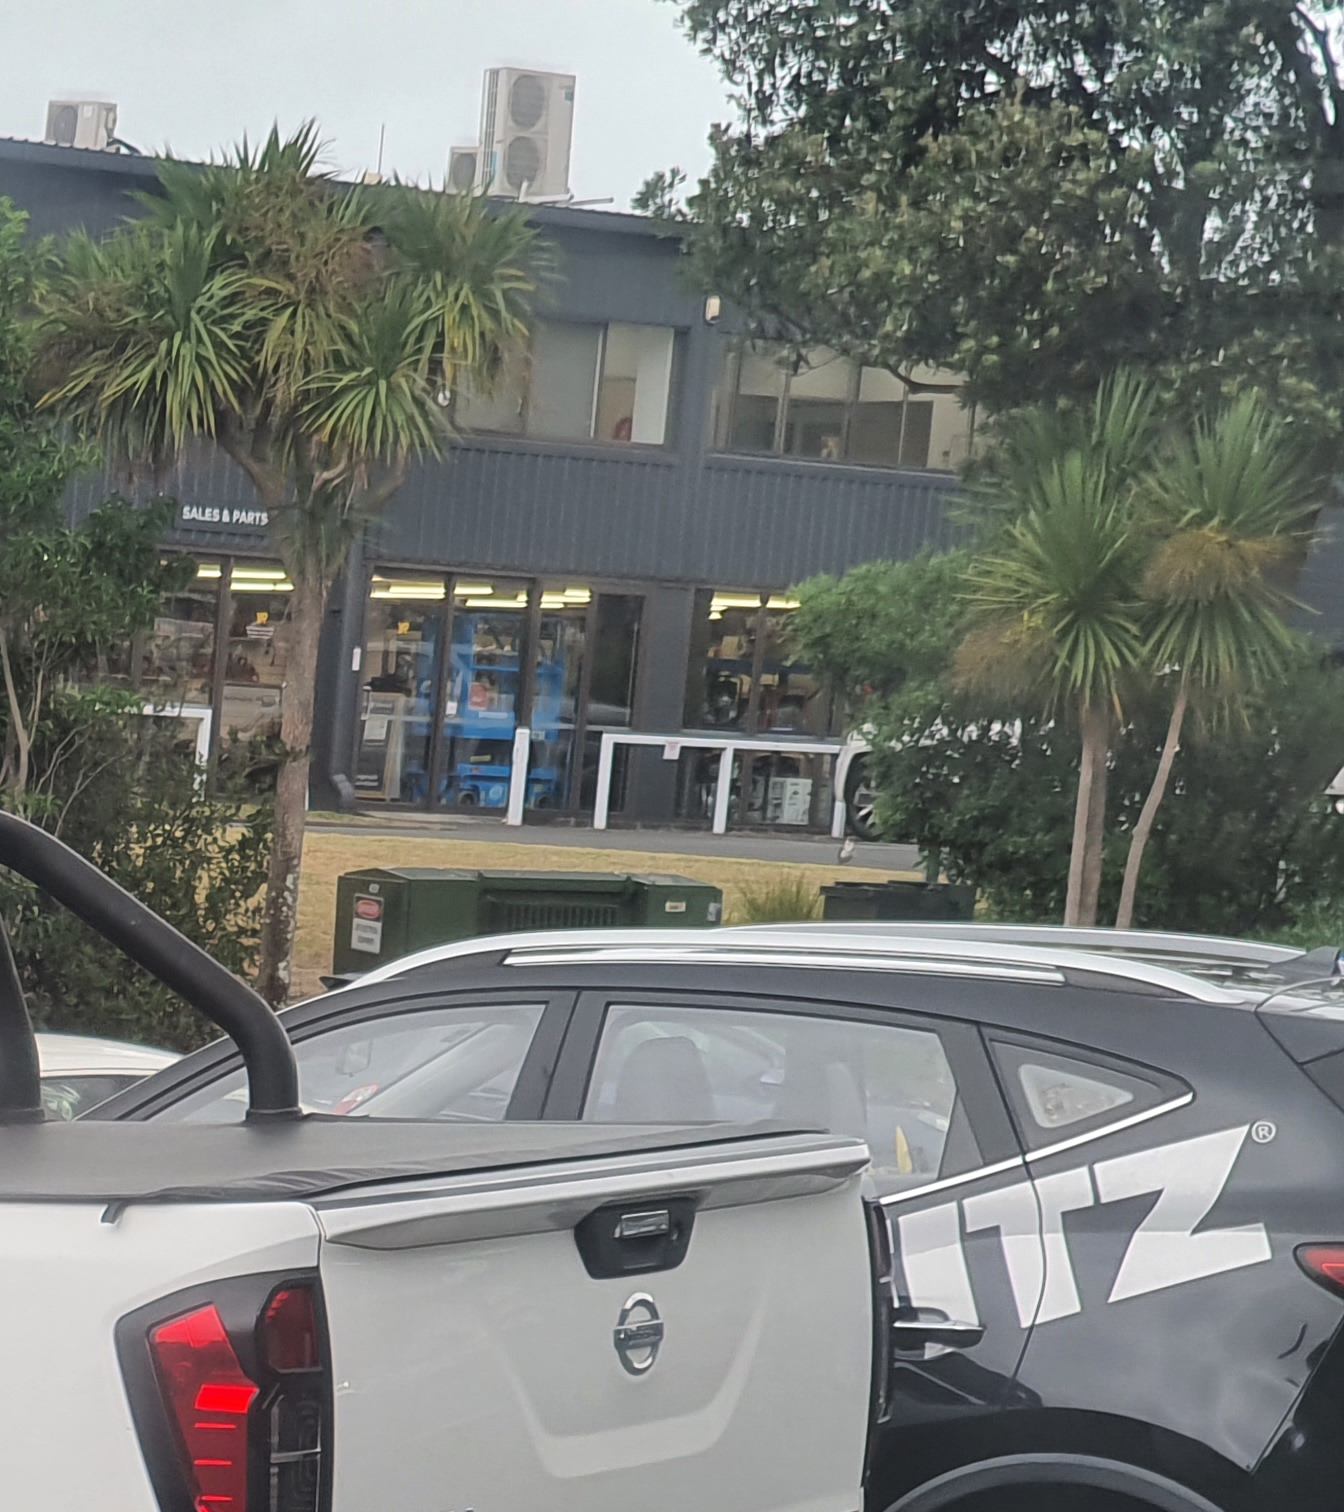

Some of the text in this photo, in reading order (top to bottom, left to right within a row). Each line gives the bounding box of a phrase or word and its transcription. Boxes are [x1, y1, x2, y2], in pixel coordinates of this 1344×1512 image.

[182, 505, 269, 526] SALES & PARTS
